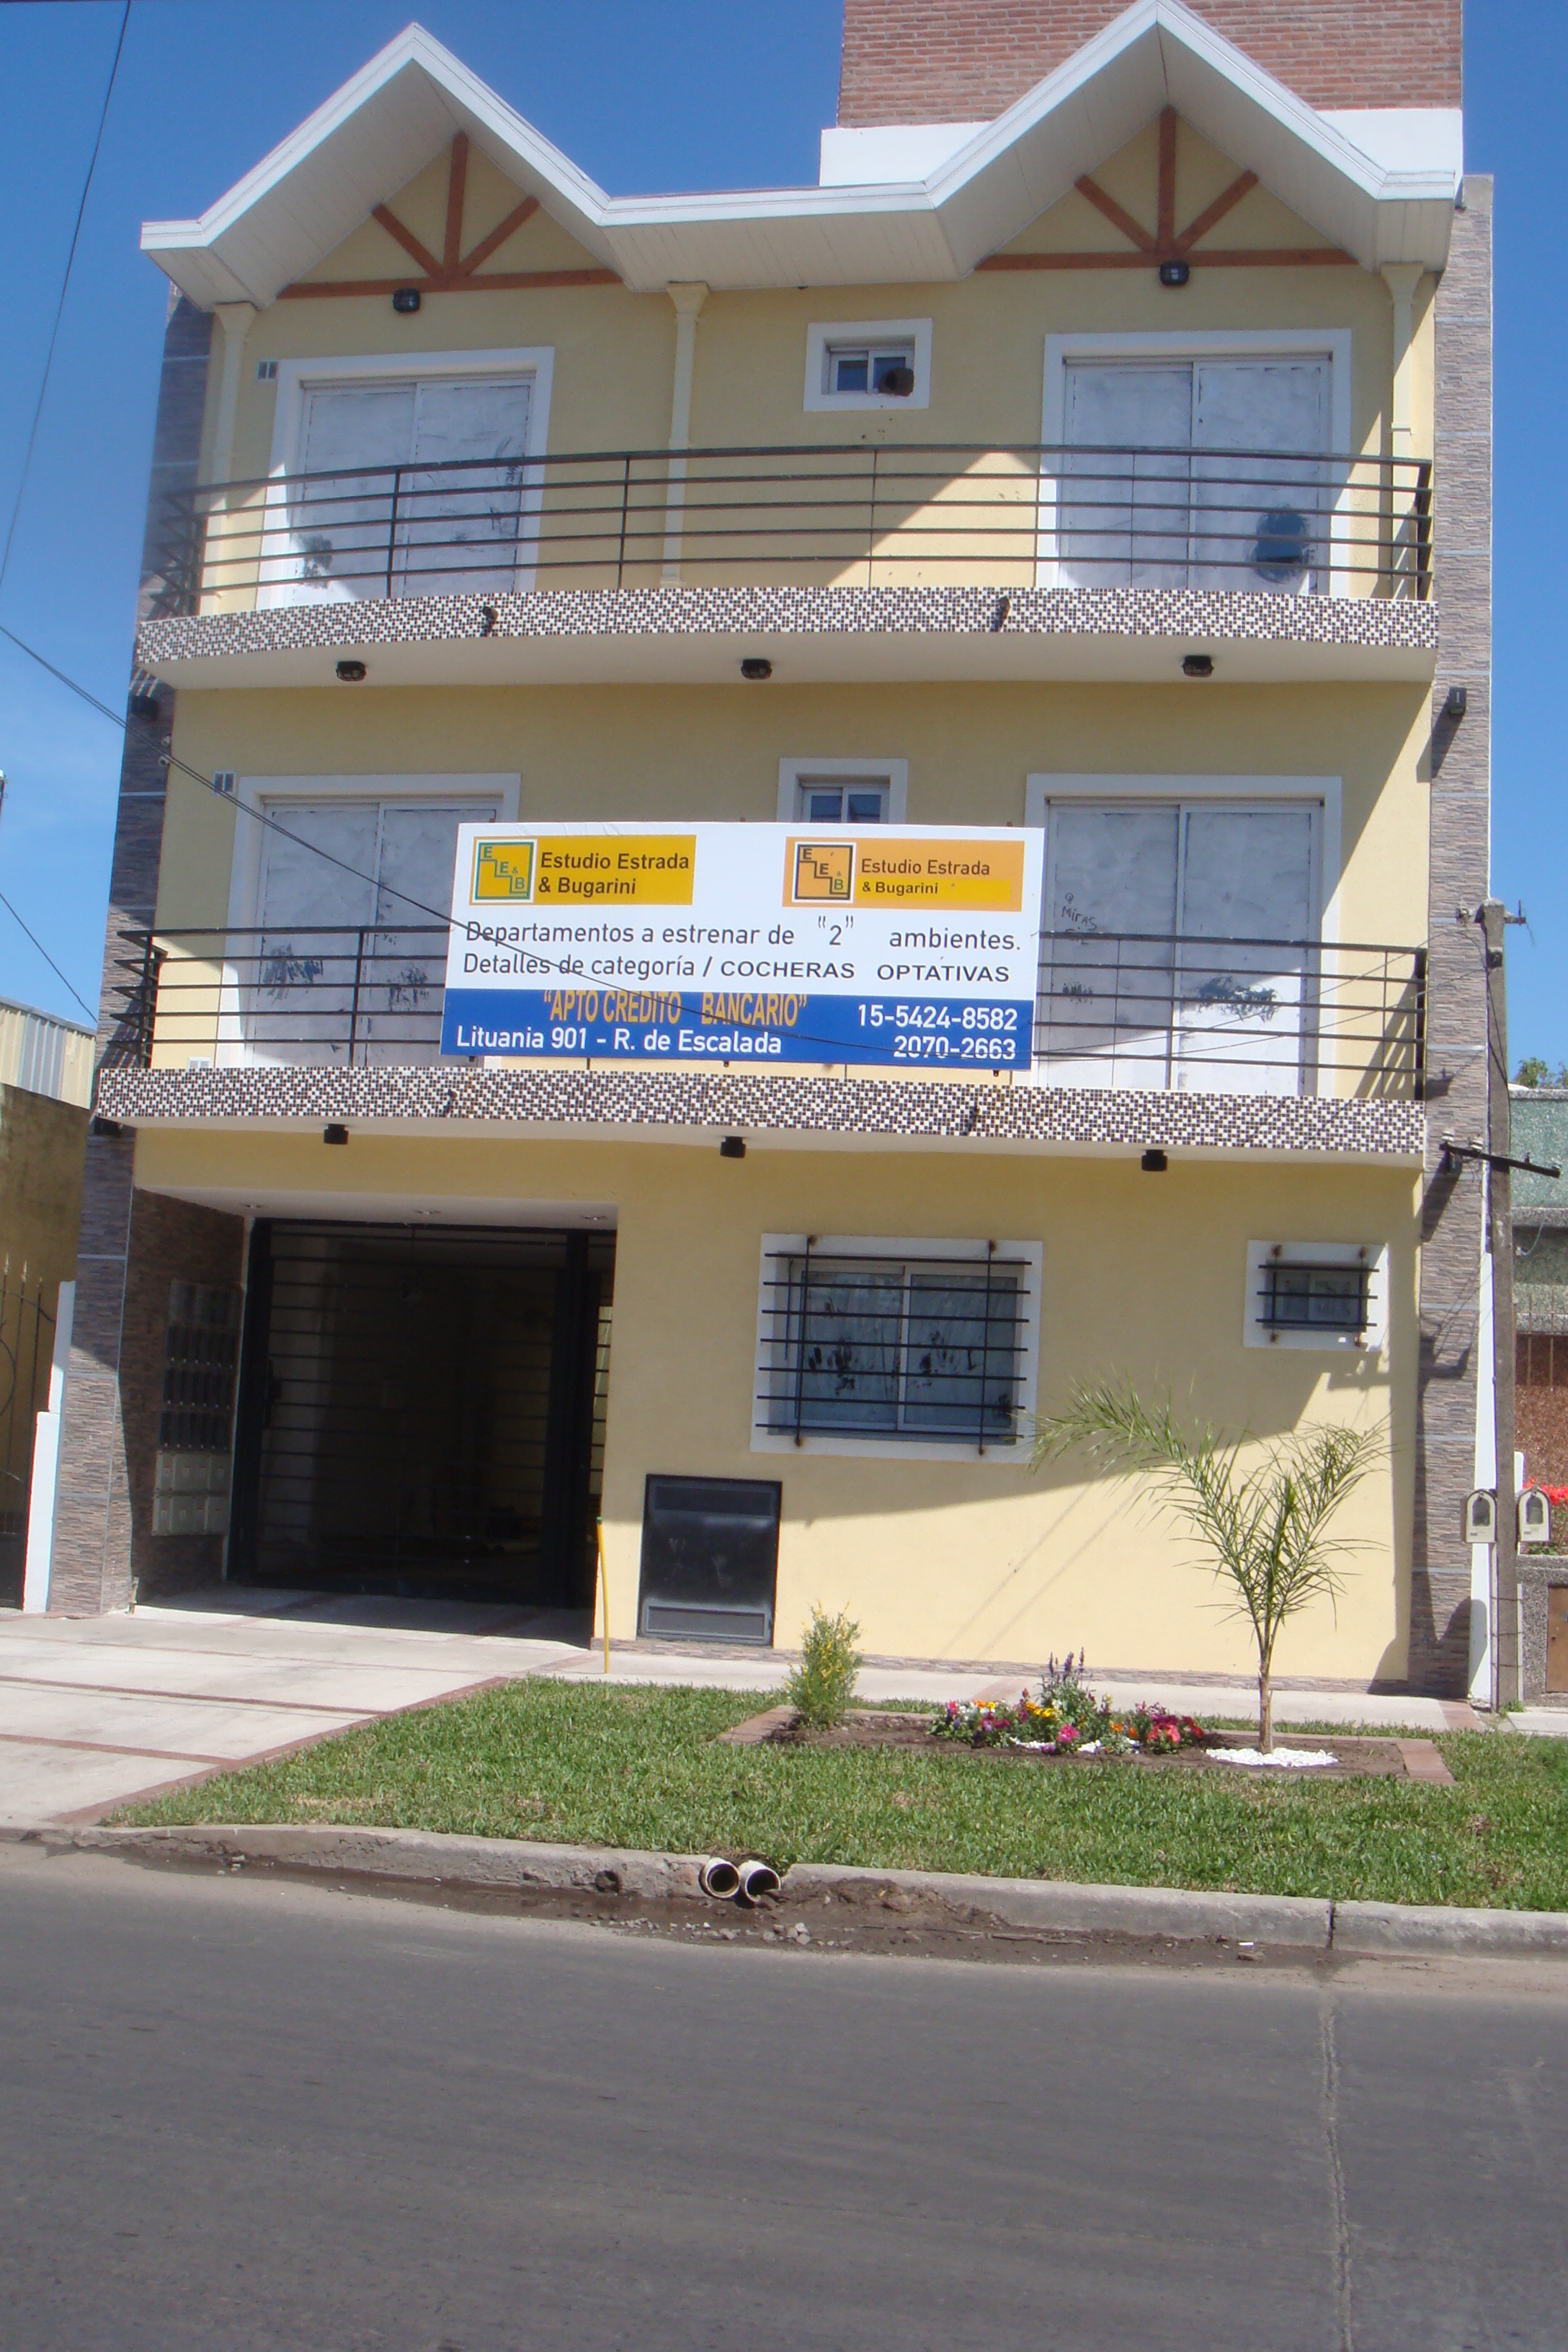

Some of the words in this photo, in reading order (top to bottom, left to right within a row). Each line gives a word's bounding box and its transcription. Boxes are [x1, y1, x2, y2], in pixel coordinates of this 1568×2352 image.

[540, 851, 611, 870] Estudio
[618, 852, 690, 870] Estrada
[861, 858, 922, 875] Estudio
[927, 859, 990, 876] Estrada
[538, 876, 551, 894] &
[558, 877, 636, 898] Bugarini
[862, 881, 871, 892] &
[876, 881, 939, 896] Bugarini
[466, 921, 633, 947] Departamentos
[641, 927, 654, 943] a
[663, 925, 760, 945] estrenar
[767, 924, 795, 945] de
[889, 927, 1021, 950] ambientes.
[463, 953, 551, 974] Detalles
[559, 954, 584, 975] de
[591, 955, 695, 980] categoría
[703, 956, 713, 977] /
[721, 960, 855, 979] COCHERAS
[876, 964, 1010, 982] OPTATIVAS
[603, 990, 682, 1024] CREDITO
[858, 1004, 1018, 1031] 15-5424-8582
[456, 1025, 544, 1048] Lituania
[550, 1027, 587, 1049] 901
[613, 1028, 636, 1051] R.
[643, 1029, 671, 1051] de
[678, 1030, 782, 1054] Escalada
[892, 1035, 1016, 1060] 2070-2663
